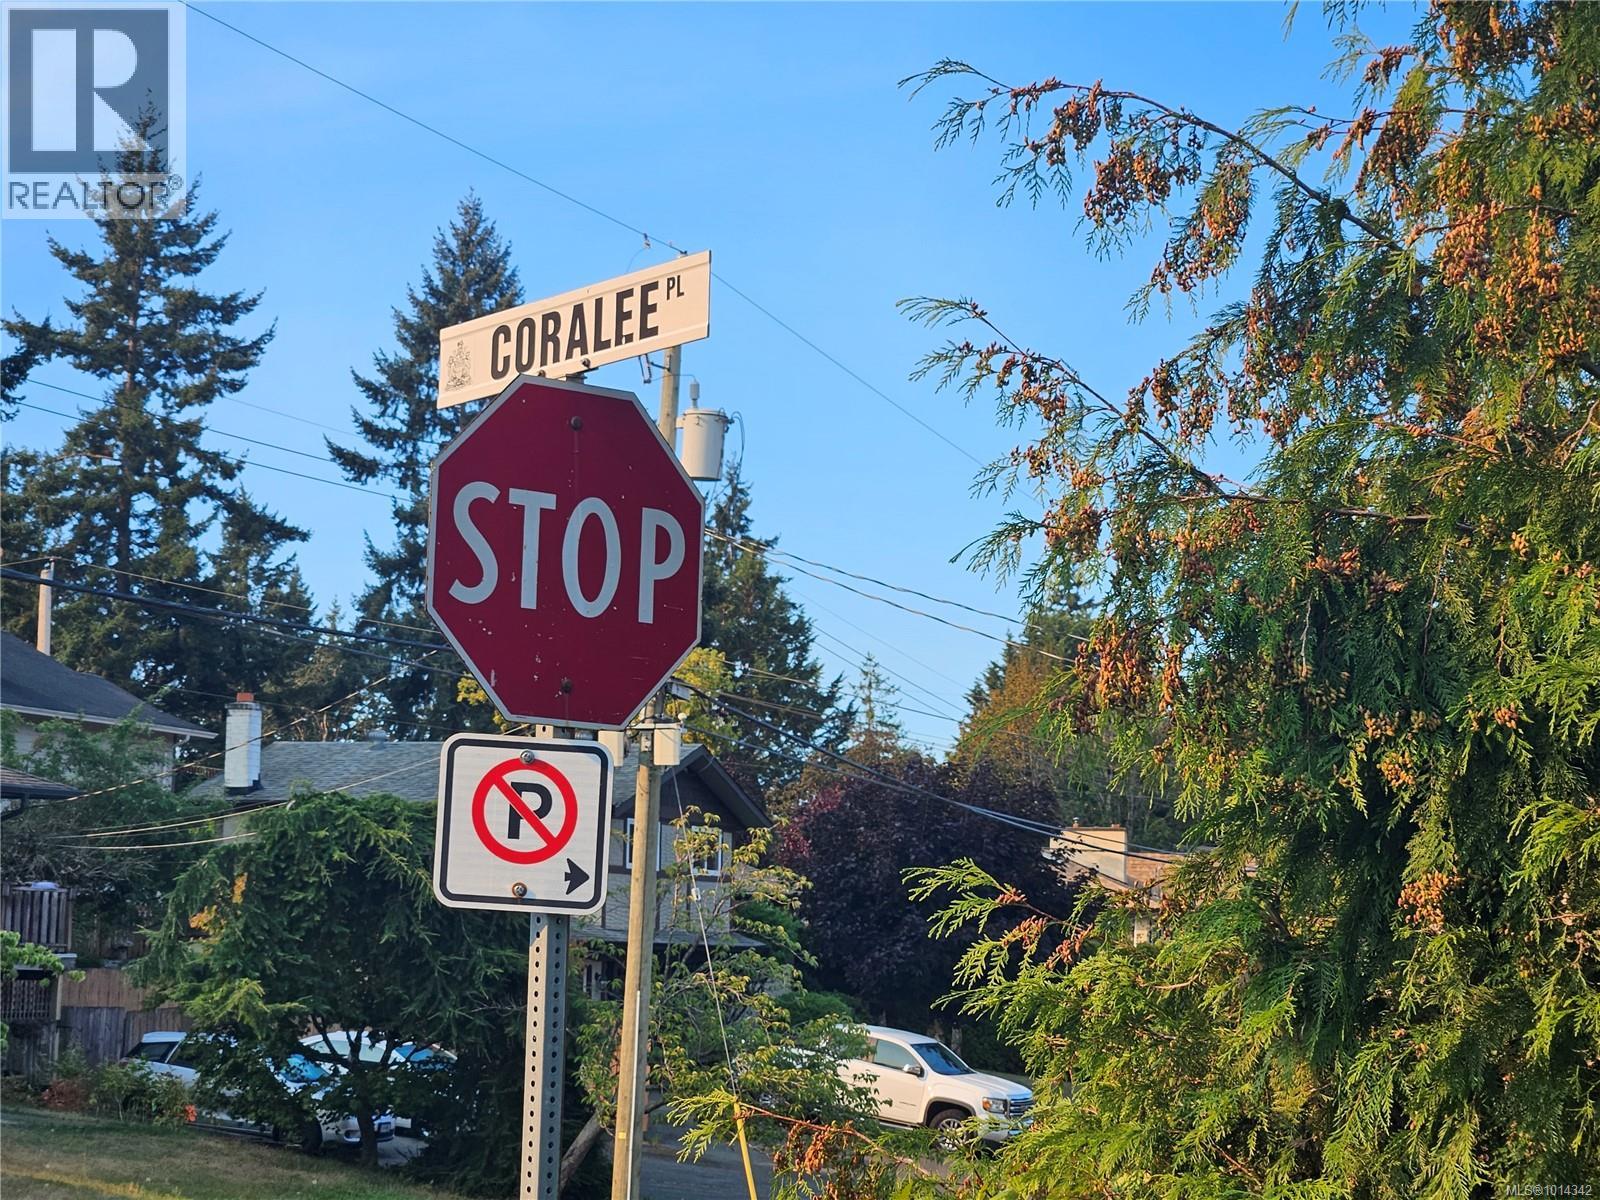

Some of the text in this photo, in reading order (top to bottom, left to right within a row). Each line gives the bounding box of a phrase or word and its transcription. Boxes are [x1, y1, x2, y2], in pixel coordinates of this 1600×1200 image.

[491, 275, 684, 380] CORALEE PL
[449, 481, 686, 624] STOP
[508, 781, 552, 839] P
